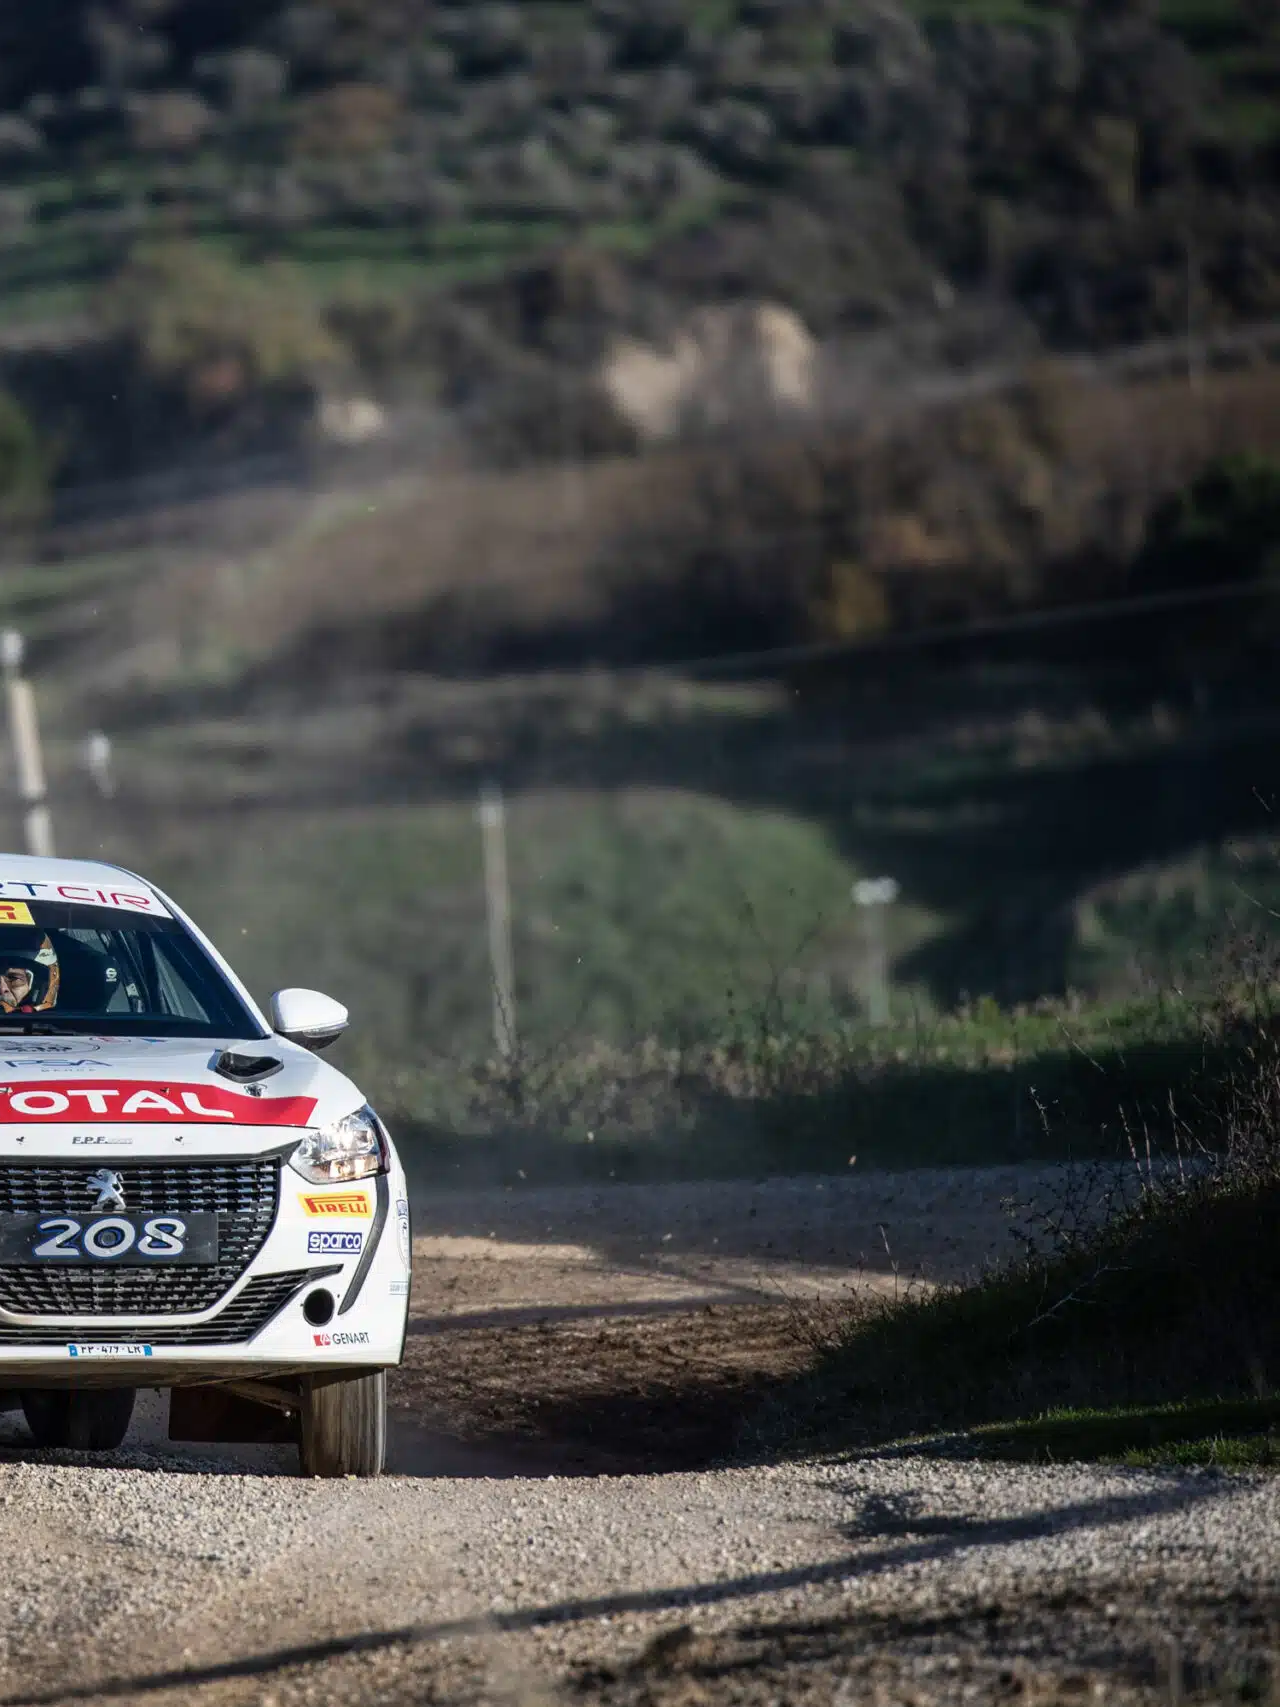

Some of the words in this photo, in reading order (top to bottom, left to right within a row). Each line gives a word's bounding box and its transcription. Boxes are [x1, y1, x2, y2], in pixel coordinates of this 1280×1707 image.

[304, 1195, 367, 1213] PIRELLI
[35, 1217, 186, 1258] 208
[309, 1232, 361, 1253] sparco
[332, 1332, 370, 1345] GENART
